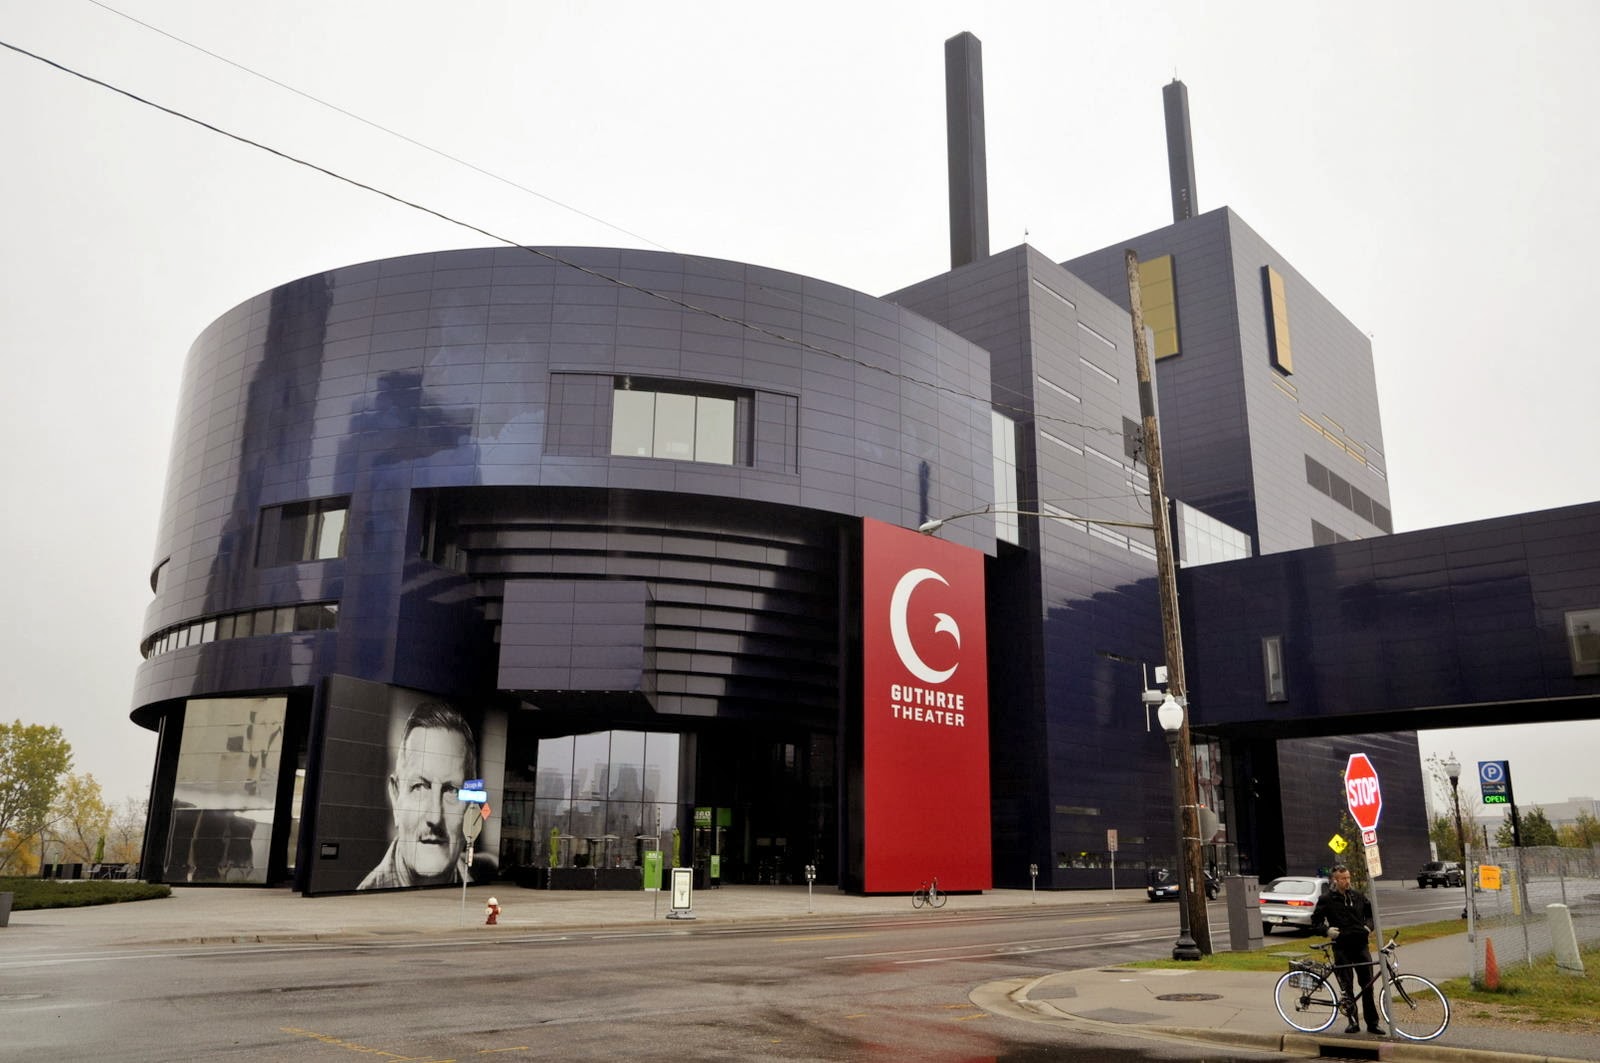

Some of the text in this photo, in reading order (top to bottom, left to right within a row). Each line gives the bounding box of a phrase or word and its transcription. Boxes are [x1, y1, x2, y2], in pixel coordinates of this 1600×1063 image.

[891, 684, 964, 711] GUTHRIE
[891, 704, 965, 727] THEATER
[1348, 777, 1378, 807] STOP
[1485, 795, 1505, 803] OPEN
